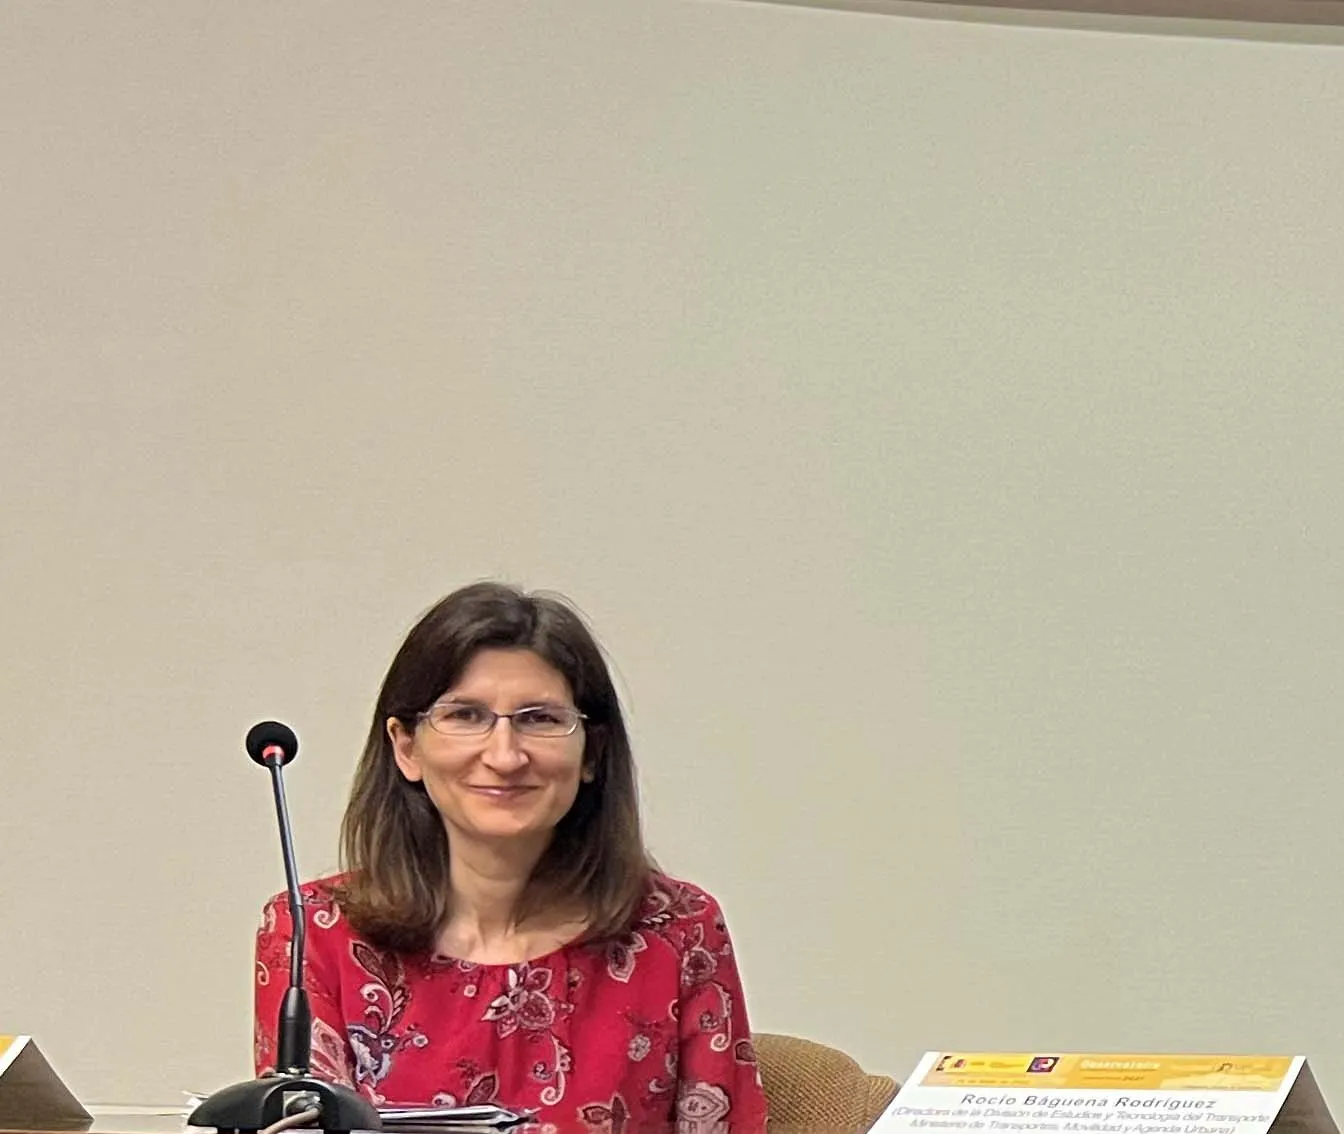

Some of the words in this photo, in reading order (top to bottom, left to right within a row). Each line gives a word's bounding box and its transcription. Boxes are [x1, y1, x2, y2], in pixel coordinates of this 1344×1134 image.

[961, 1093, 1017, 1106] Rocío
[1024, 1094, 1108, 1110] Báguena
[1114, 1096, 1217, 1111] Rodríguez
